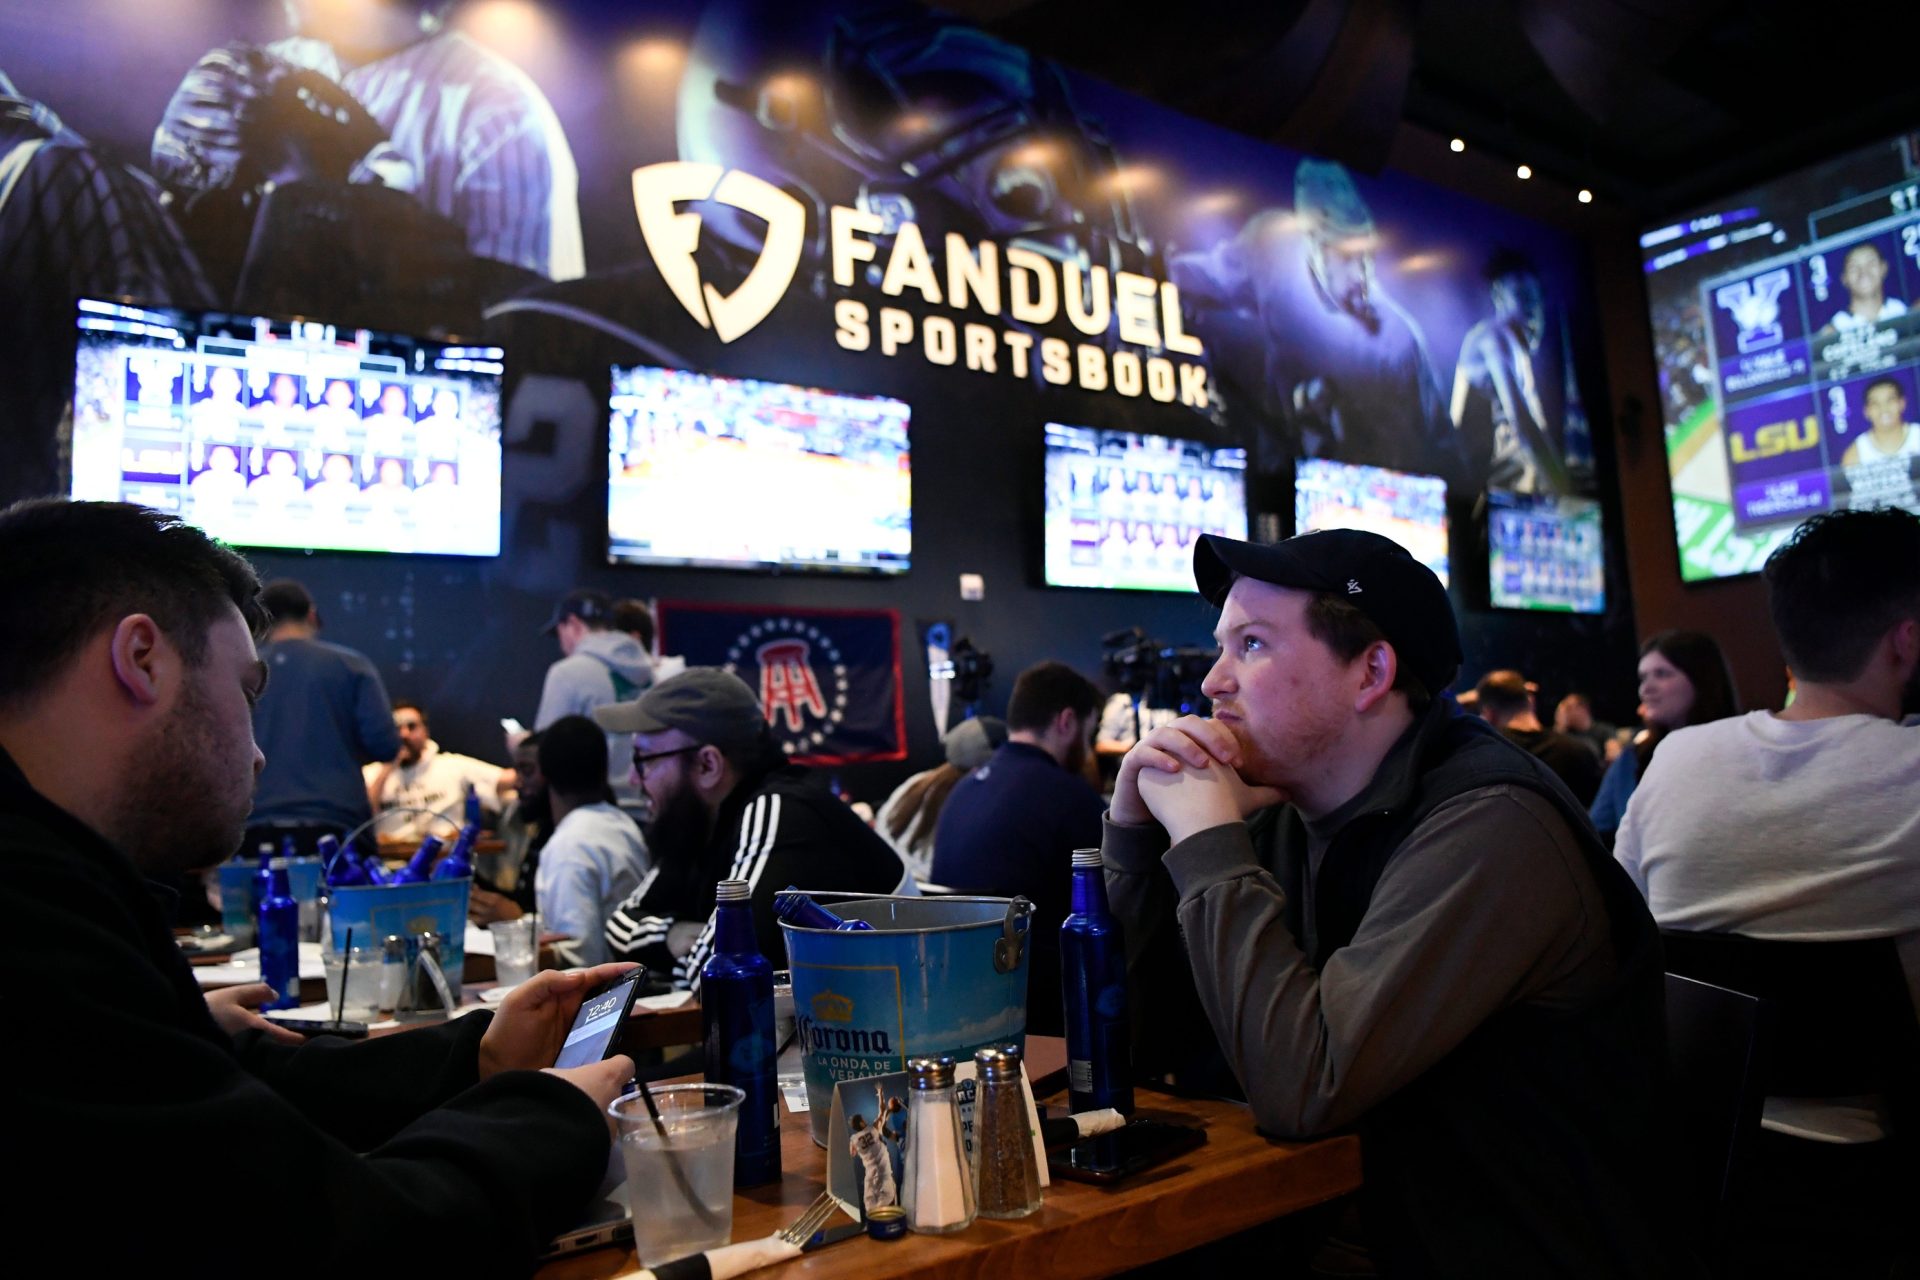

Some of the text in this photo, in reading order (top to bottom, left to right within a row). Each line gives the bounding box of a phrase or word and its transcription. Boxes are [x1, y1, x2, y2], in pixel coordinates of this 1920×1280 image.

[830, 204, 1204, 356] FANDUEL
[835, 299, 1209, 408] SPORTSBOOK
[1729, 414, 1820, 464] LSU
[588, 996, 617, 1018] 12:40
[799, 1014, 893, 1056] Corona
[817, 1055, 891, 1072] LA ONDA DE
[829, 1068, 890, 1081] VERAN
[858, 1132, 875, 1149] 32
